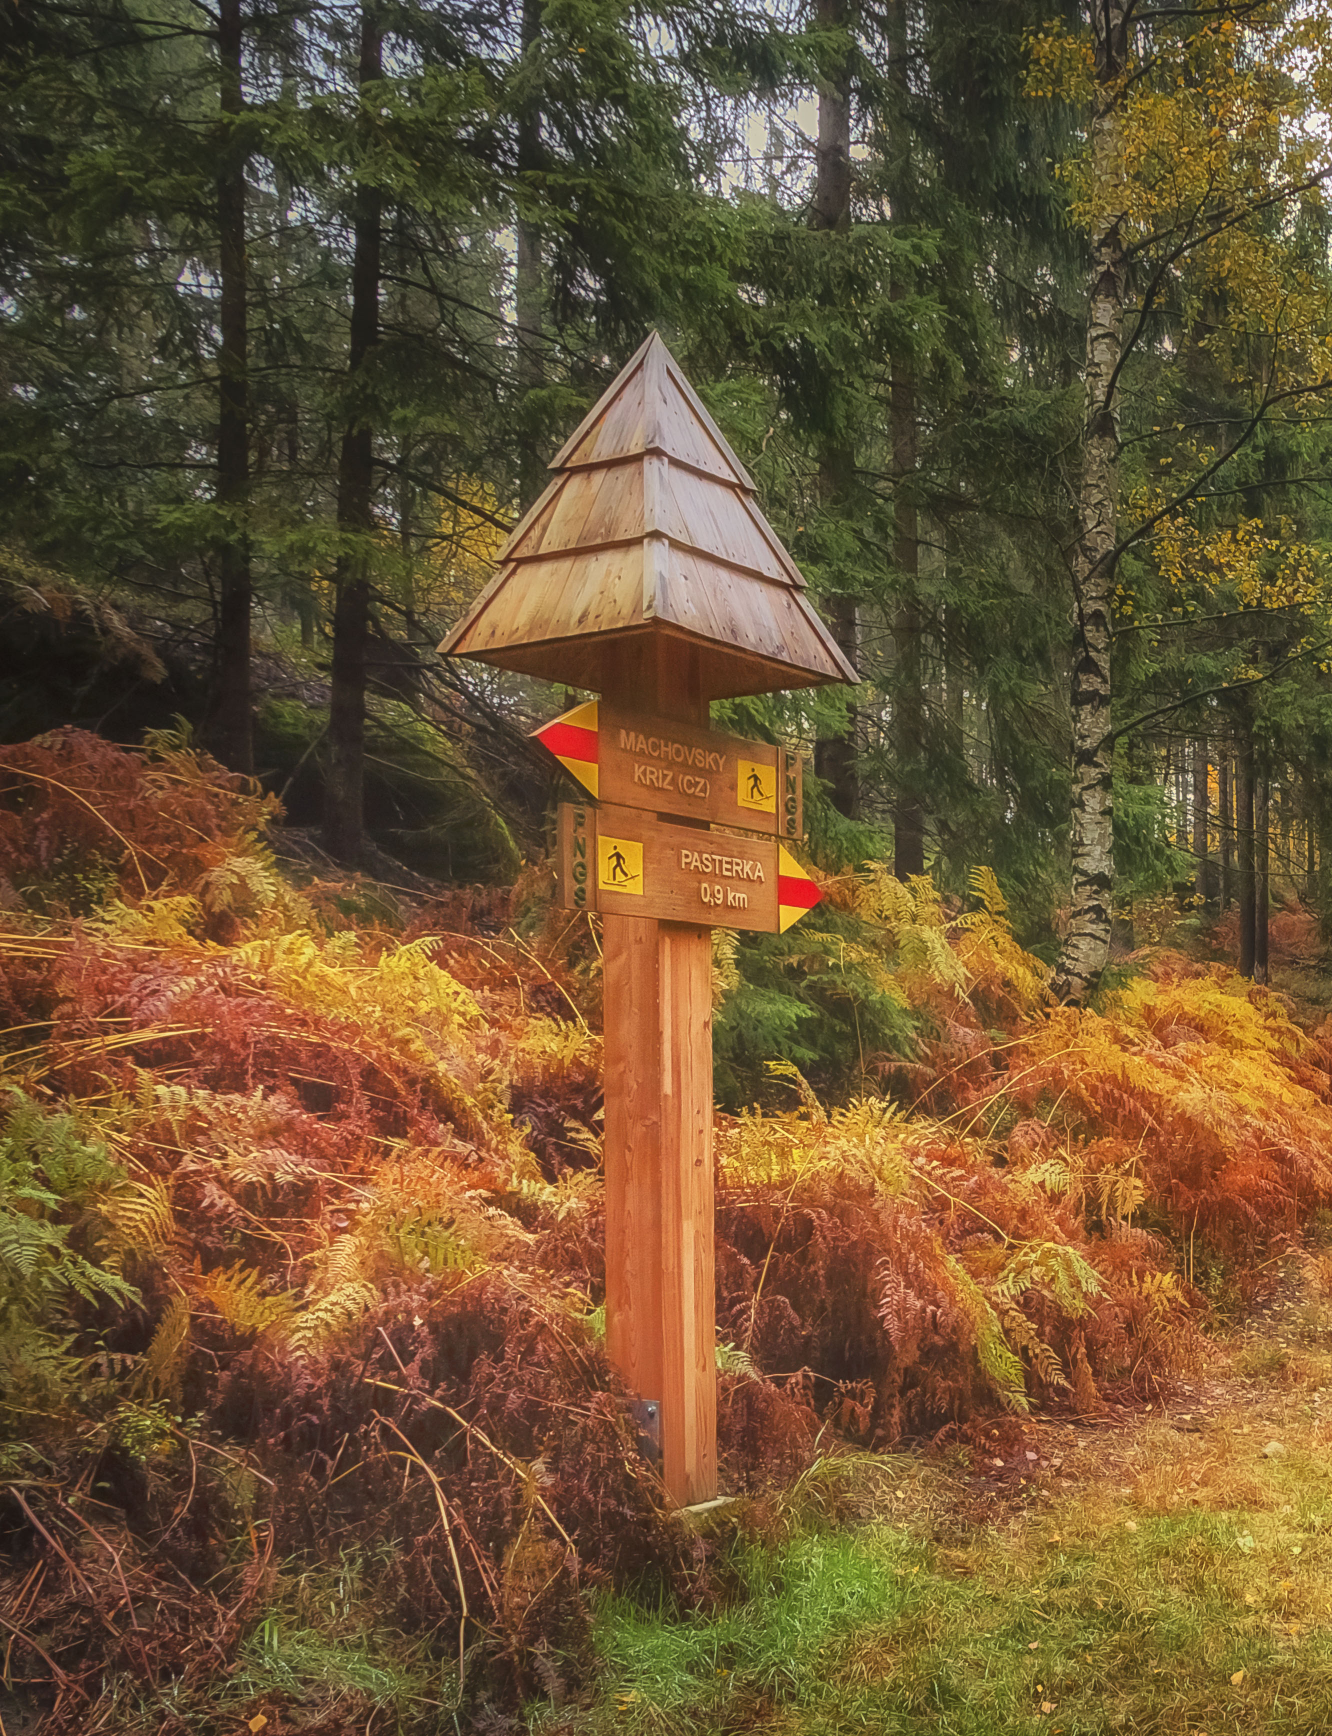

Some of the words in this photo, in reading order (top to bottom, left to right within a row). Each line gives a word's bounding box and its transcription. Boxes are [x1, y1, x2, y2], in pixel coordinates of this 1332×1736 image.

[620, 729, 727, 772] MACHOVSKY
[634, 763, 673, 790] KRIZ
[678, 773, 710, 798] (CZ)
[785, 752, 798, 835] PNGS
[572, 810, 587, 907] PNGS
[681, 850, 765, 882] PASTERKA
[701, 883, 724, 906] 0,9
[727, 886, 748, 909] km
